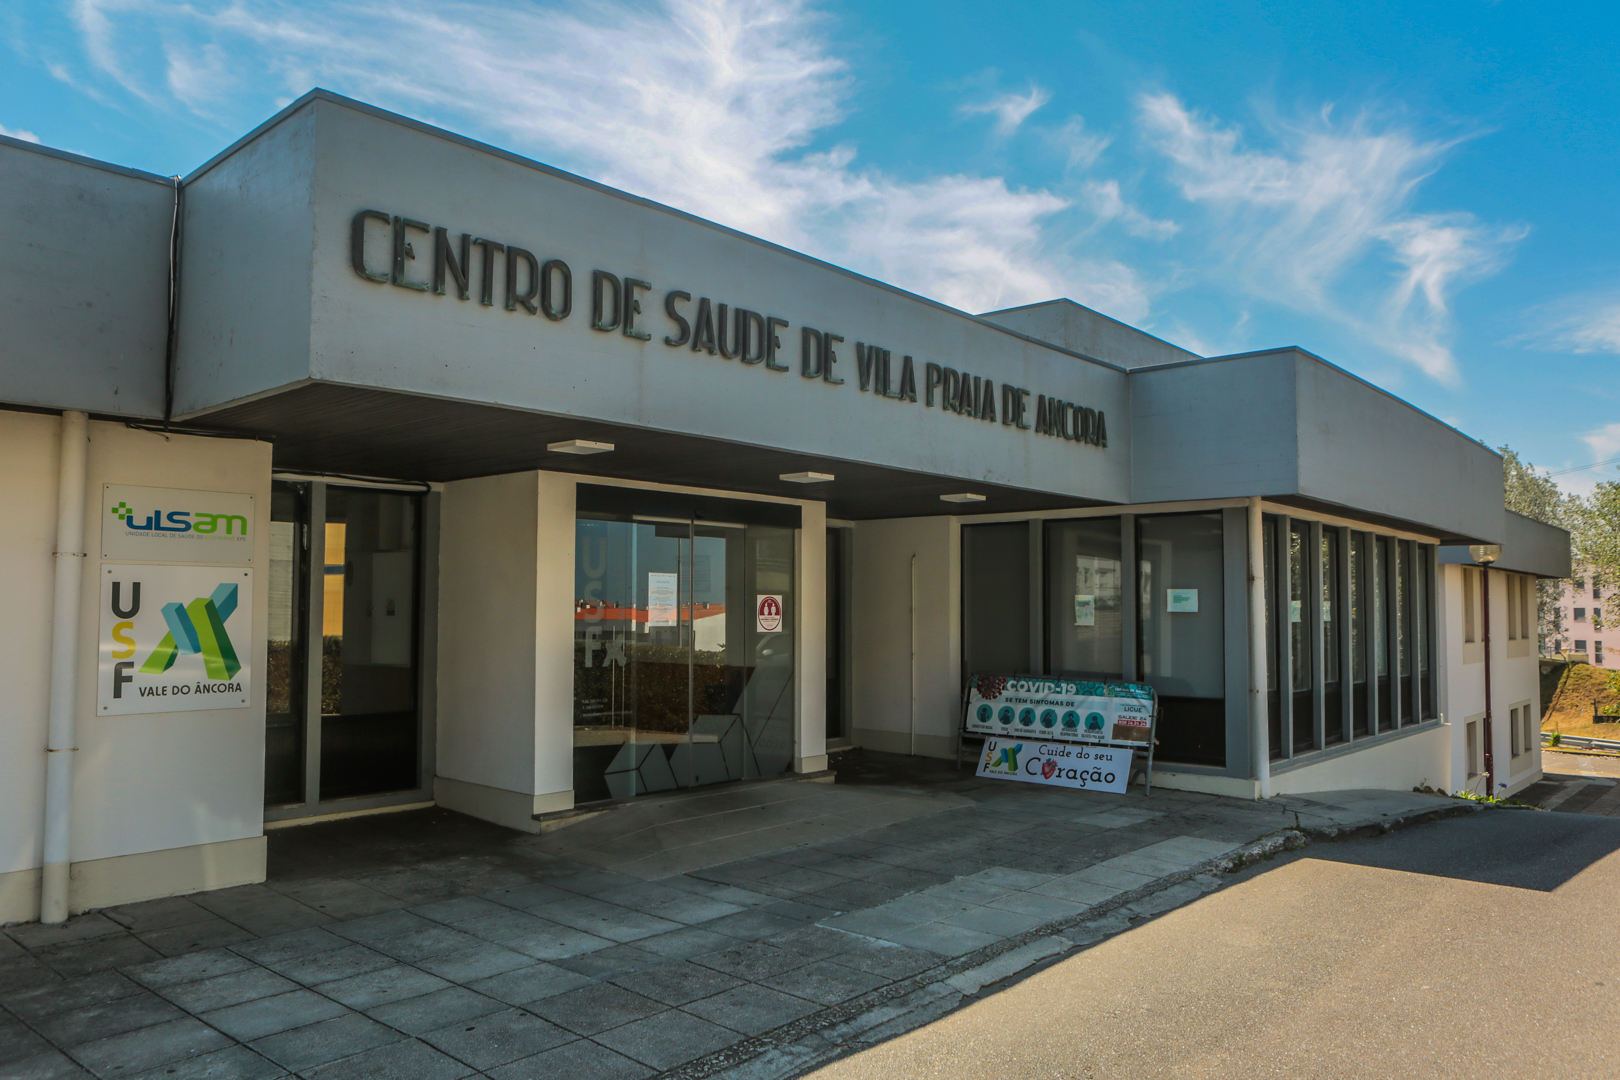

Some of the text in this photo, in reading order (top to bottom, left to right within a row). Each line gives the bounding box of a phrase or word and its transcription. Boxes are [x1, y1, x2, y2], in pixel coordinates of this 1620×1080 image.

[351, 209, 1109, 449] CENTRO DE SAUDE DE VILA PRAIA DE ANCORA
[139, 681, 243, 698] VALE DO ÂNCORA
[1006, 680, 1077, 696] COVID-19
[1029, 699, 1064, 707] SINTOMAS
[1038, 744, 1113, 762] Cuide do seu
